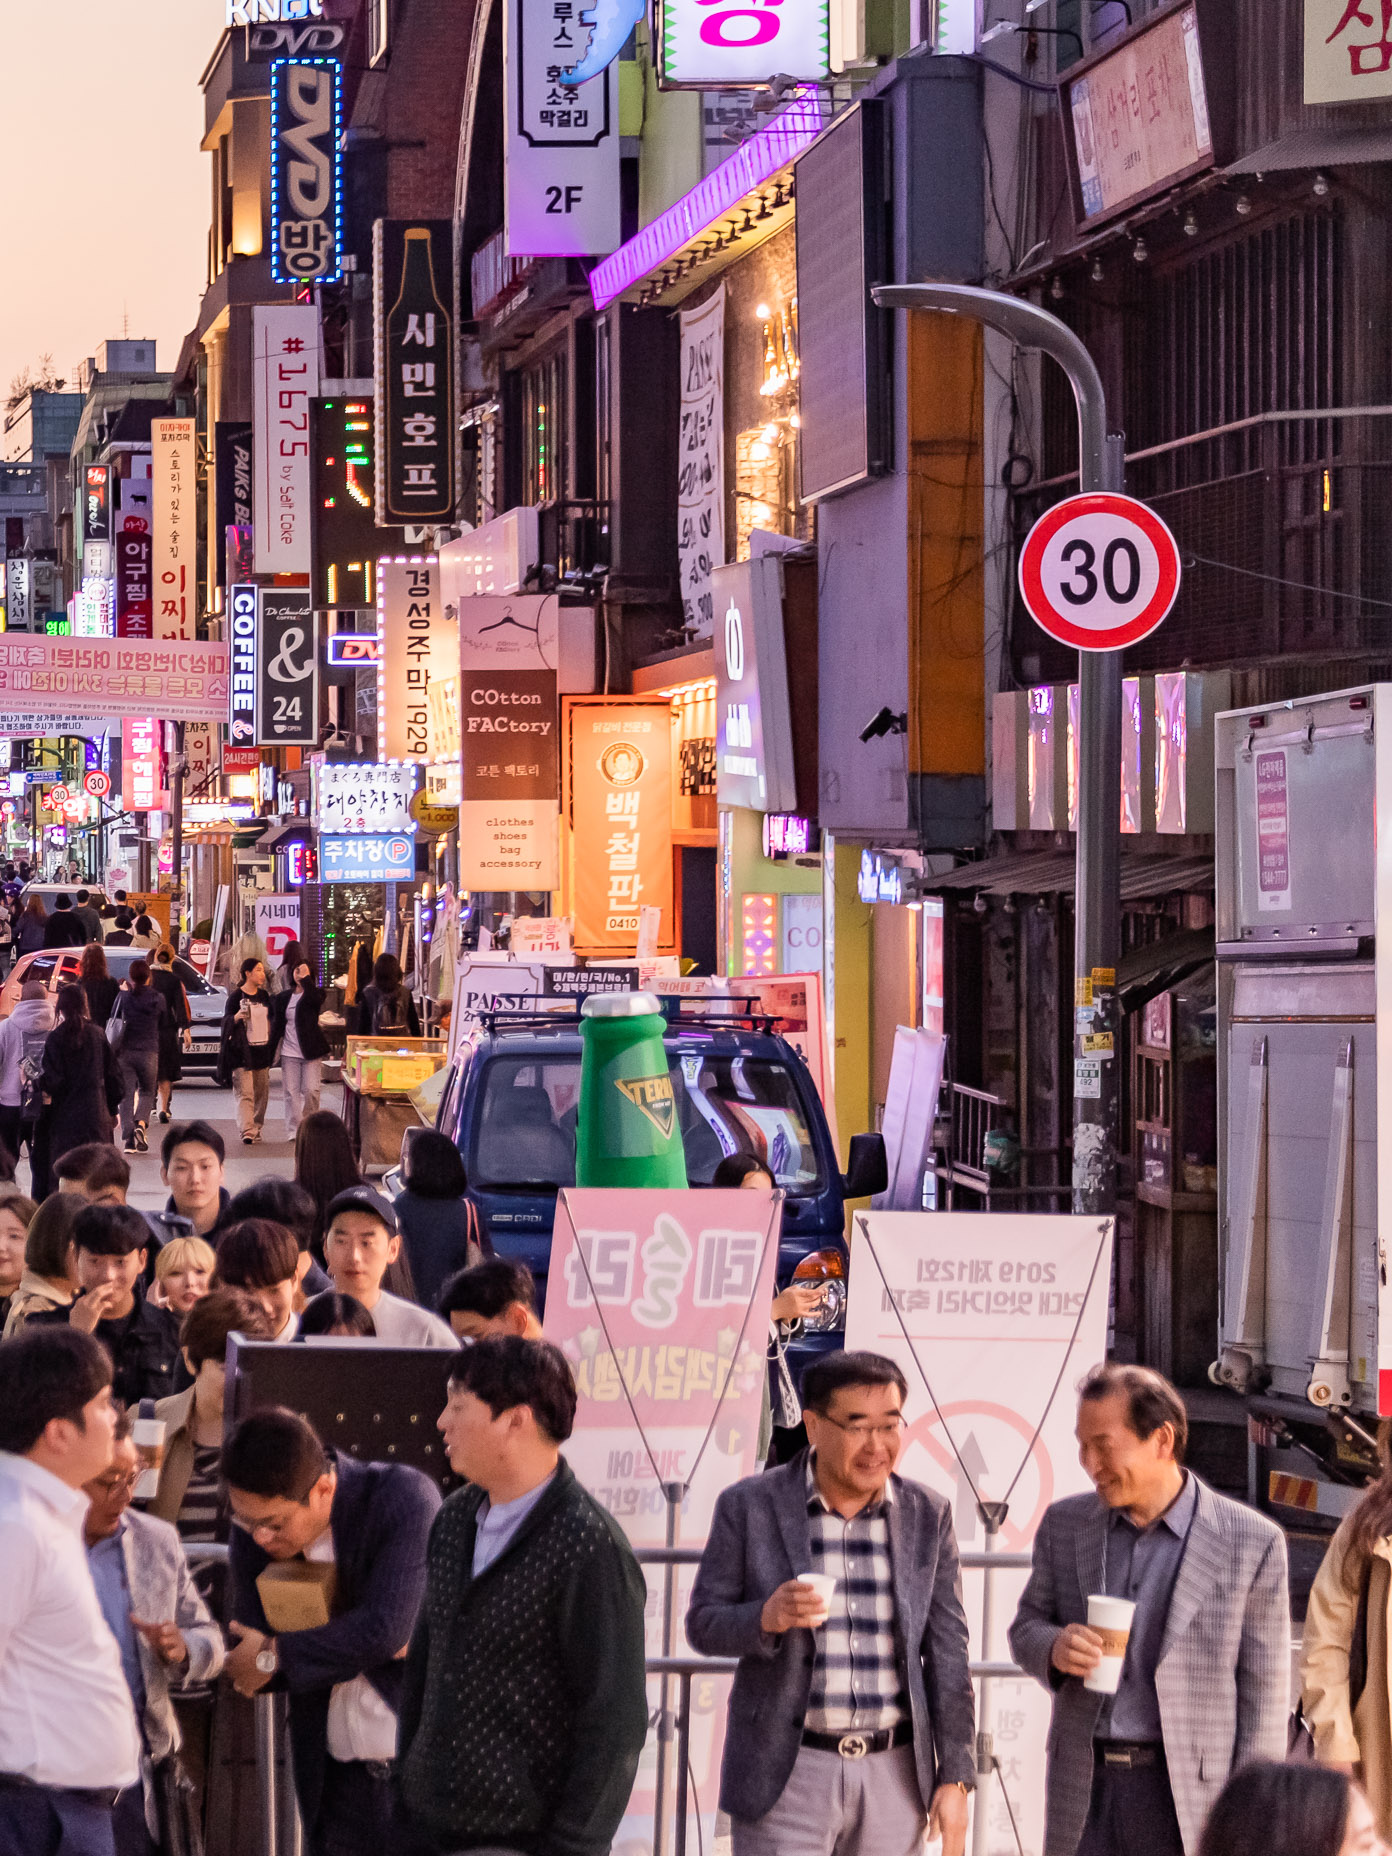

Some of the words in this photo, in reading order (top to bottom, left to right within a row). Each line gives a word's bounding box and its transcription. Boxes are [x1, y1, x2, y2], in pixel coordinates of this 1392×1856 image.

[249, 25, 344, 53] DVD
[538, 109, 589, 128] 막걸리
[544, 186, 584, 215] 2F
[277, 337, 308, 457] #1675
[401, 312, 439, 496] 시민호프
[282, 465, 294, 482] by
[279, 486, 295, 516] Salt
[279, 519, 296, 545] Coke
[1059, 538, 1141, 605] 30
[233, 593, 255, 711] COFFEE
[470, 689, 542, 705] COtton
[272, 696, 303, 722] 24
[467, 717, 552, 736] FACtory
[475, 764, 501, 777] 코튼
[504, 764, 540, 777] 팩토리
[90, 778, 104, 790] 30
[54, 790, 66, 800] 30
[327, 788, 408, 816] 대양참치
[485, 816, 535, 828] clothes
[492, 830, 528, 842] shoes
[325, 840, 385, 864] 주차장
[499, 844, 522, 858] bag
[604, 790, 644, 912] 백철판
[479, 858, 542, 871] accessory
[608, 918, 638, 930] 0410
